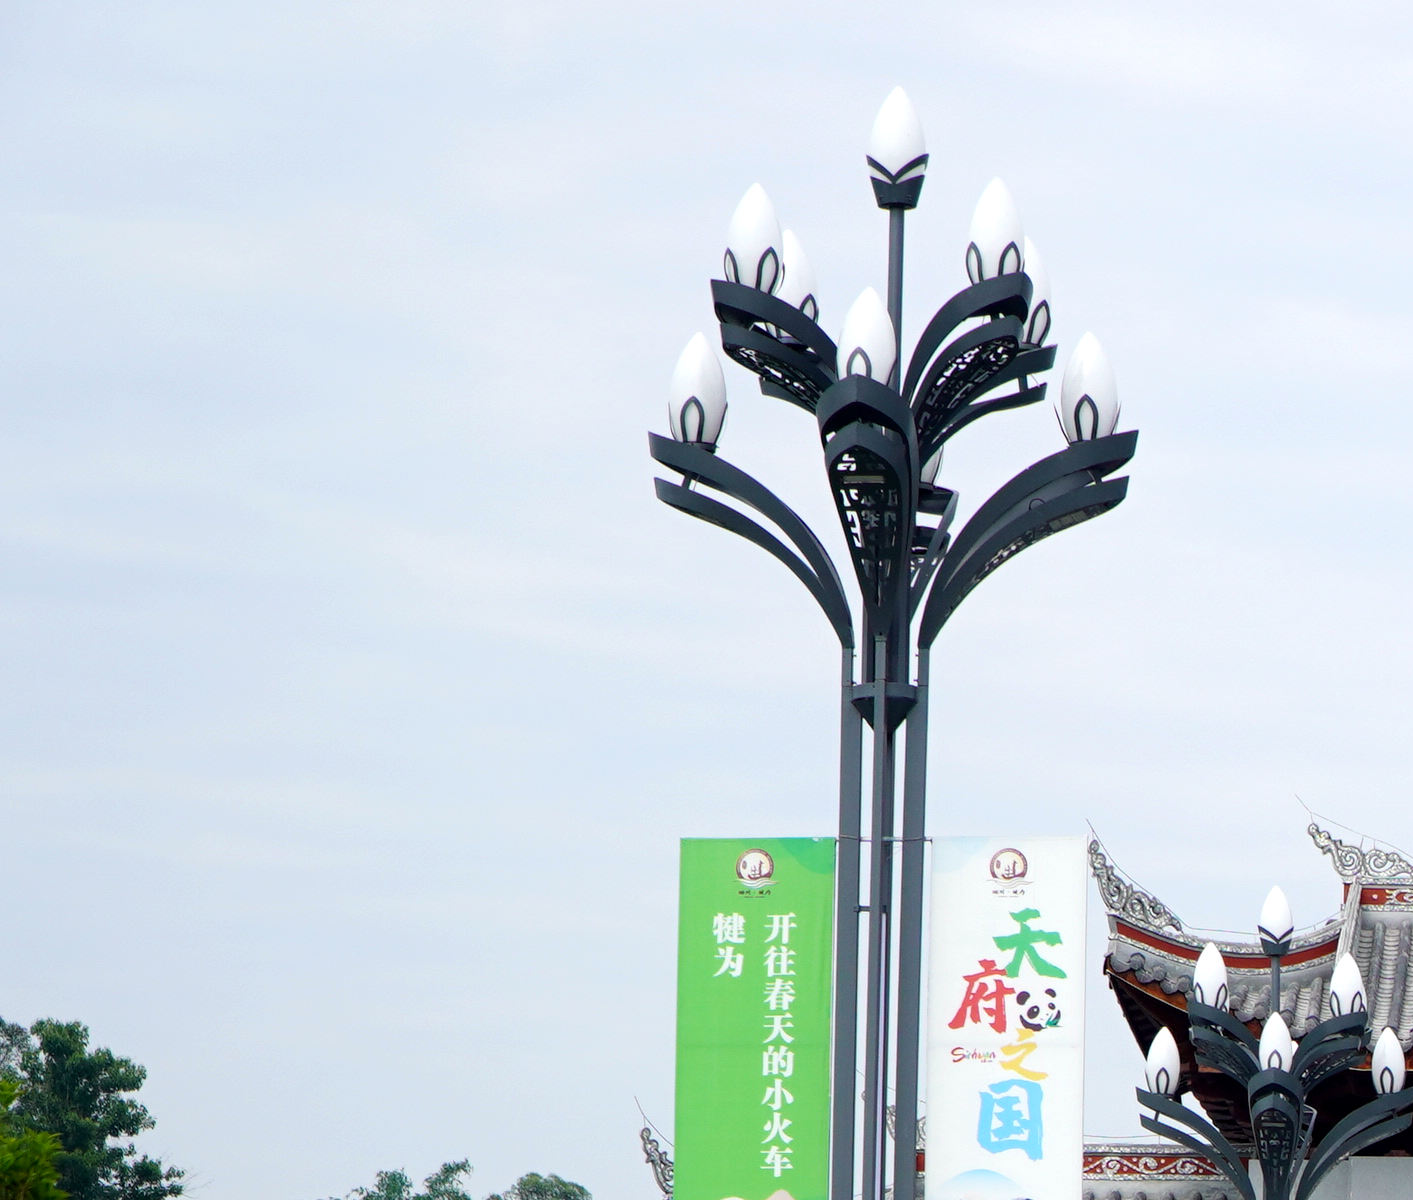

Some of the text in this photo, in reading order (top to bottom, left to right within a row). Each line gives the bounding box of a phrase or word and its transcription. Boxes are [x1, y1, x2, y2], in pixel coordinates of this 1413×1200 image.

[713, 913, 746, 977] 犍为
[760, 912, 798, 1178] 开往春天的小火车
[947, 908, 1067, 1160] 天府之国
